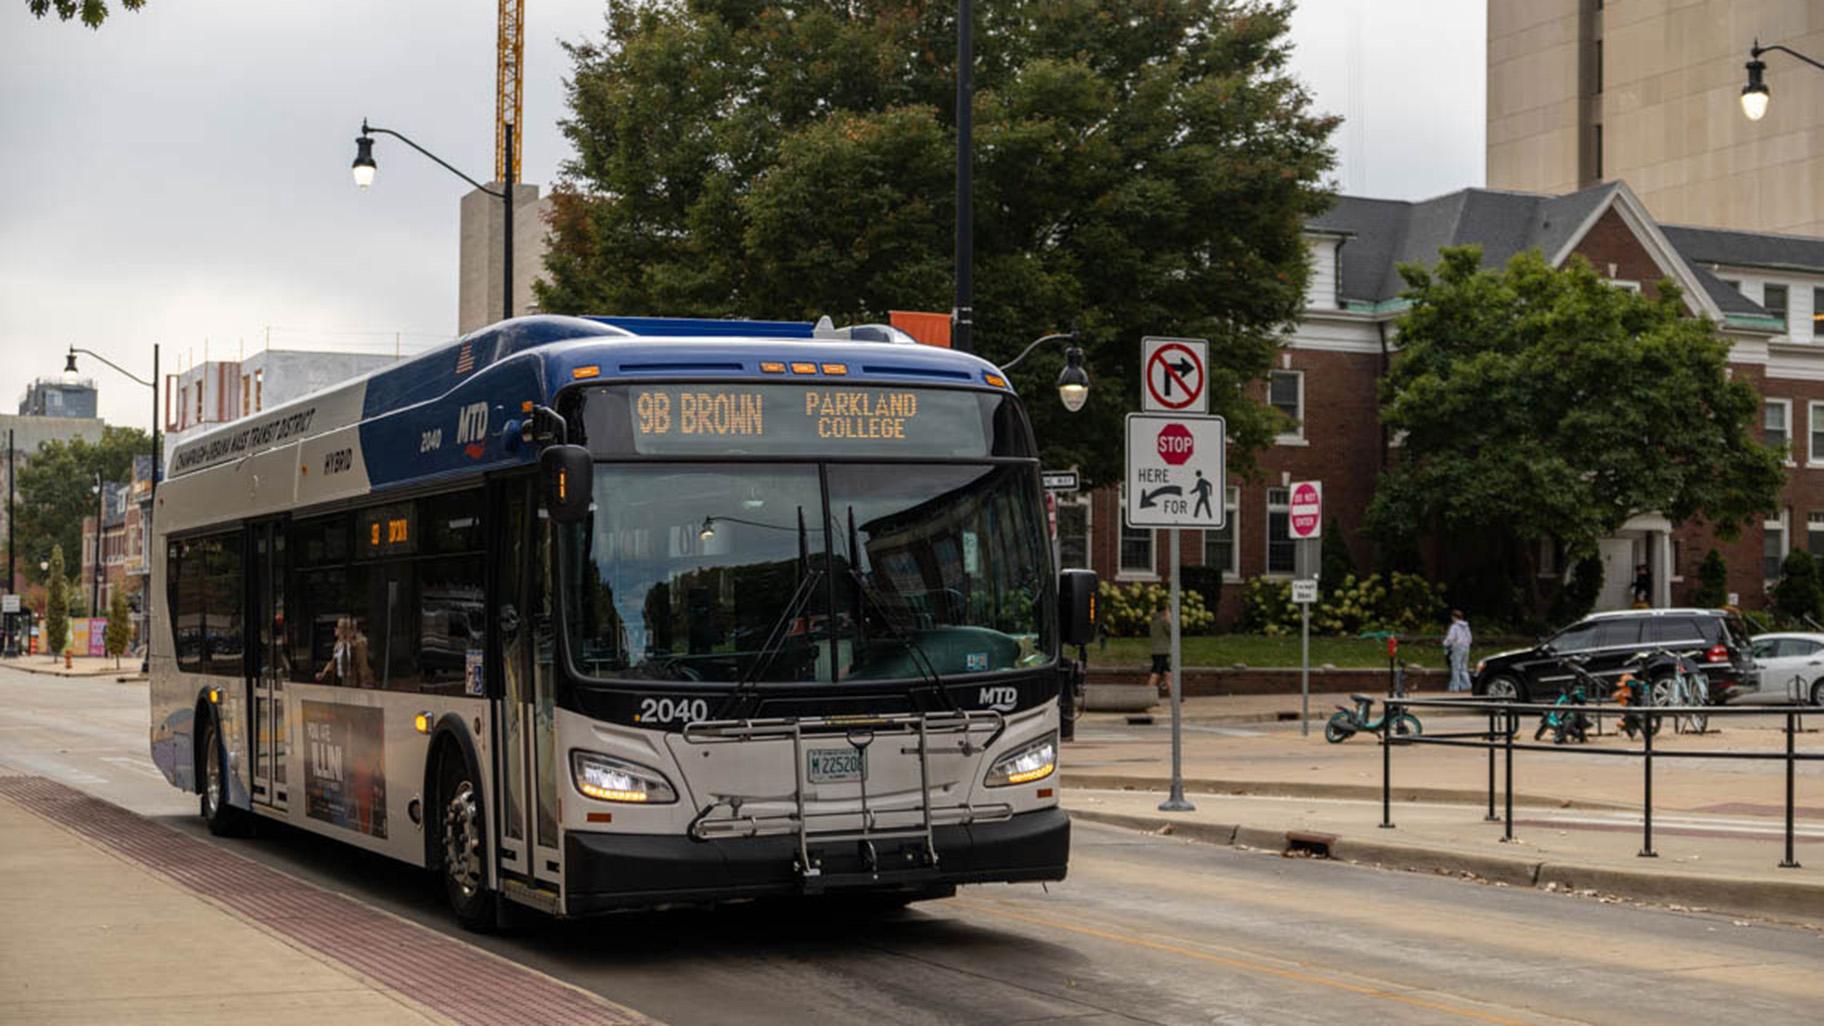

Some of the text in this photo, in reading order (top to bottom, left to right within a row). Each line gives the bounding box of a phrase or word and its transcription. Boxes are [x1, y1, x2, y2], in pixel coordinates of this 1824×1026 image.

[637, 392, 763, 435] 9B BROWN
[805, 391, 918, 417] PARKLAND
[457, 401, 488, 444] MTD
[818, 417, 906, 439] COLLEGE
[1158, 436, 1193, 453] STOP
[323, 448, 353, 476] HYBRID
[1138, 468, 1169, 483] HERE
[1164, 500, 1187, 514] FOR
[979, 687, 1018, 706] MTD
[641, 698, 707, 723] 2040
